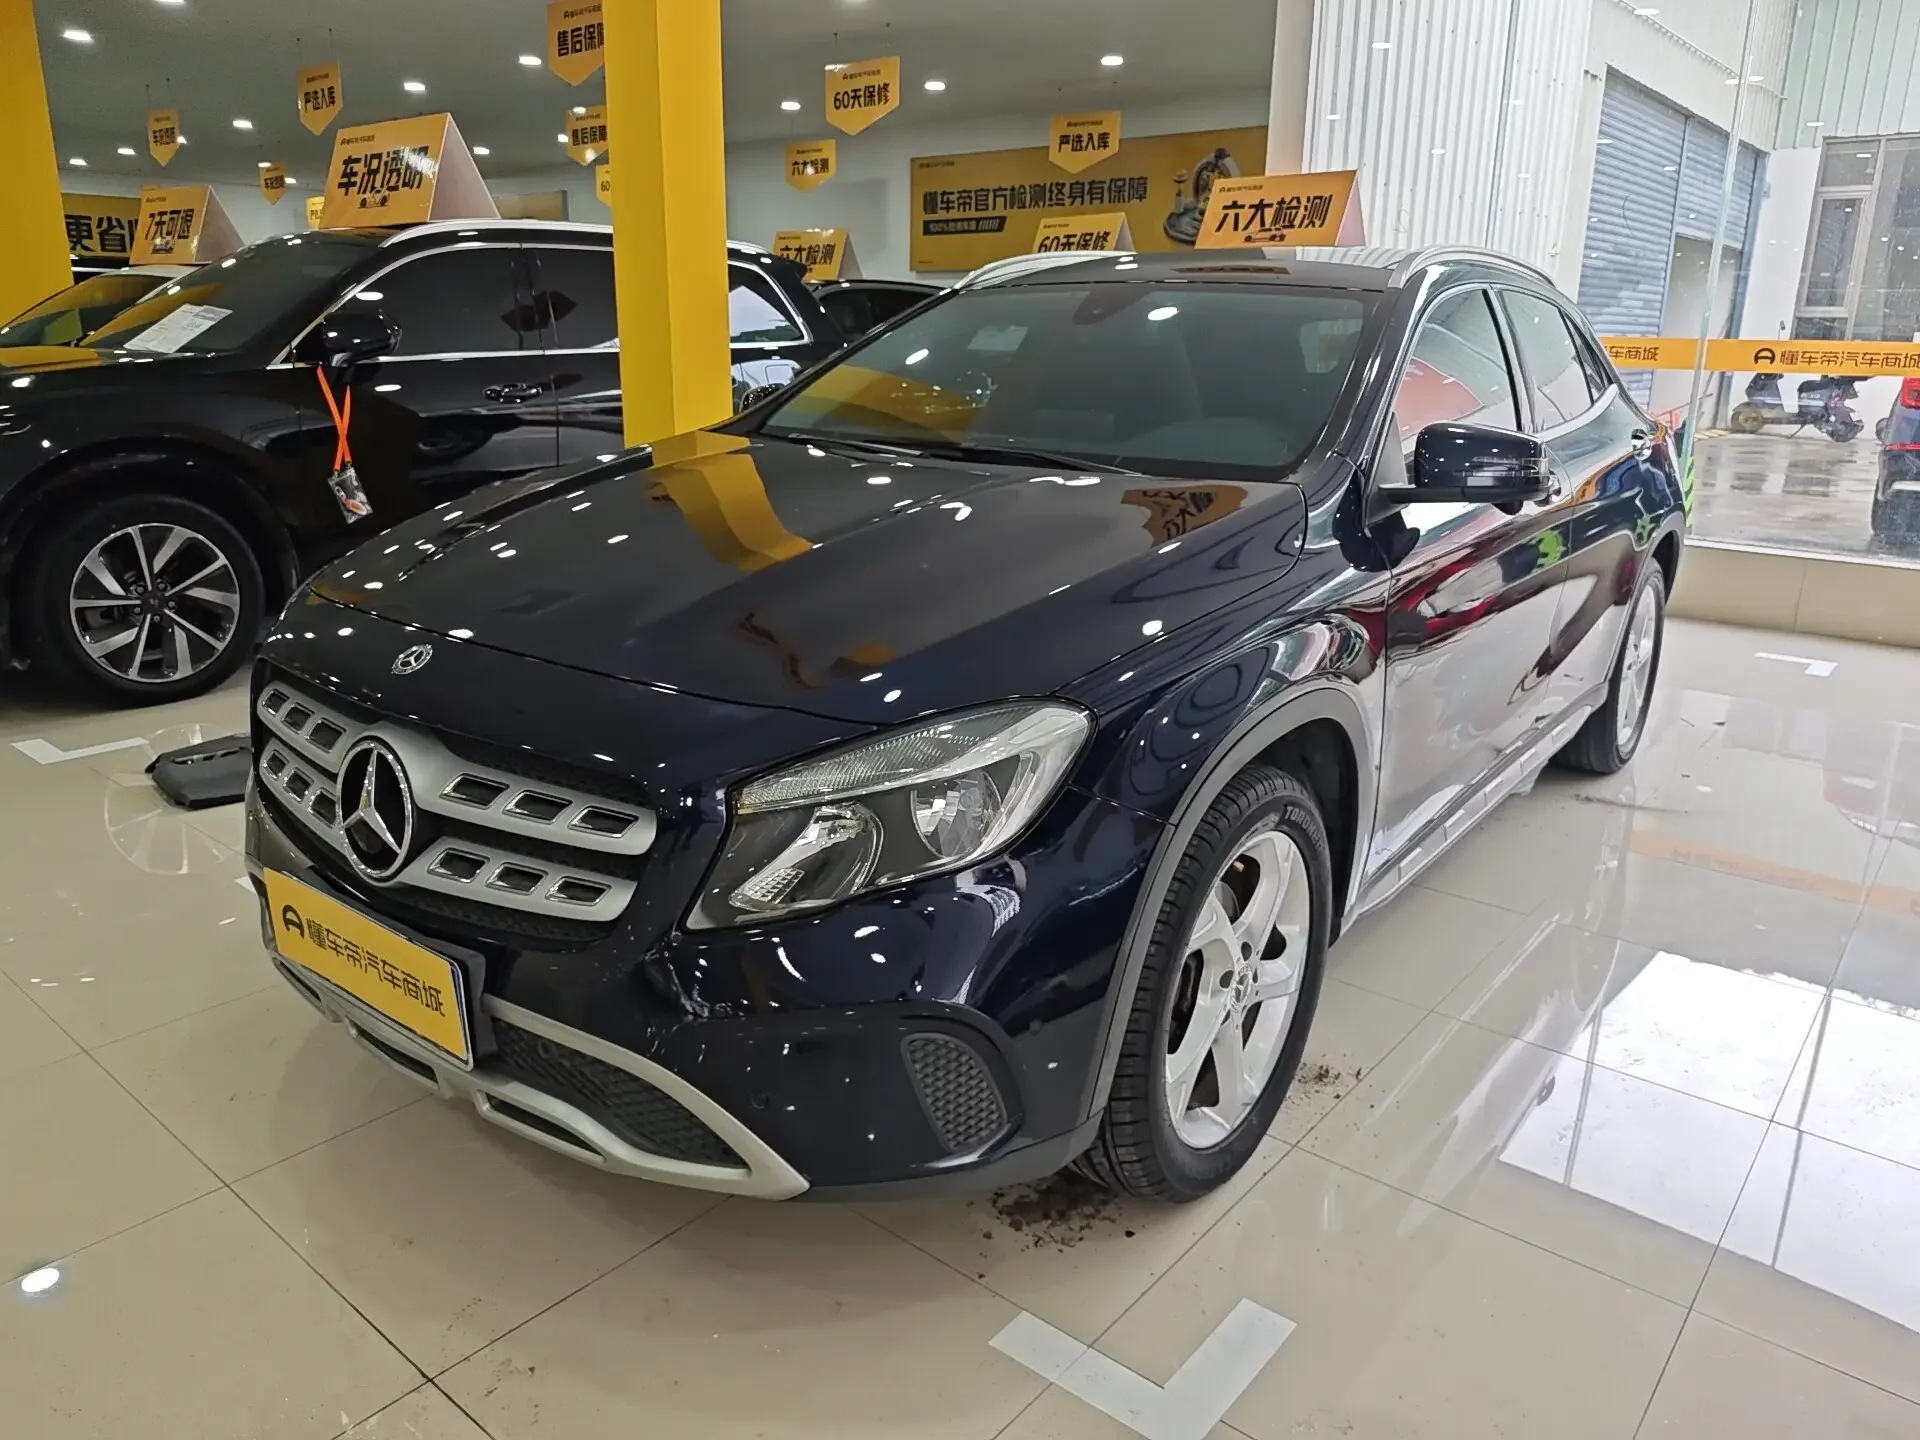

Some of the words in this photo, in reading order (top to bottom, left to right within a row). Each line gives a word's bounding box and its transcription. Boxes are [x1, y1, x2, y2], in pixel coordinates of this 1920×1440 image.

[303, 86, 336, 112] 严选入库
[833, 83, 890, 110] 60天保修
[572, 124, 608, 146] 售后保障
[1058, 132, 1110, 153] 严选入库
[337, 145, 430, 196] 车况透明
[792, 158, 829, 176] 六大检测
[923, 176, 1149, 215] 懂车帝官方检测终身有保障
[145, 208, 195, 241] 7天可退
[1215, 194, 1333, 232] 六大检测
[64, 214, 138, 253] 更省
[1038, 231, 1111, 252] 60天保修
[778, 243, 837, 265] 六大检测
[1604, 345, 1660, 361] 车商城
[1780, 350, 1920, 369] 懂车帝汽车商城
[306, 918, 446, 1017] 懂车帝汽车商城
